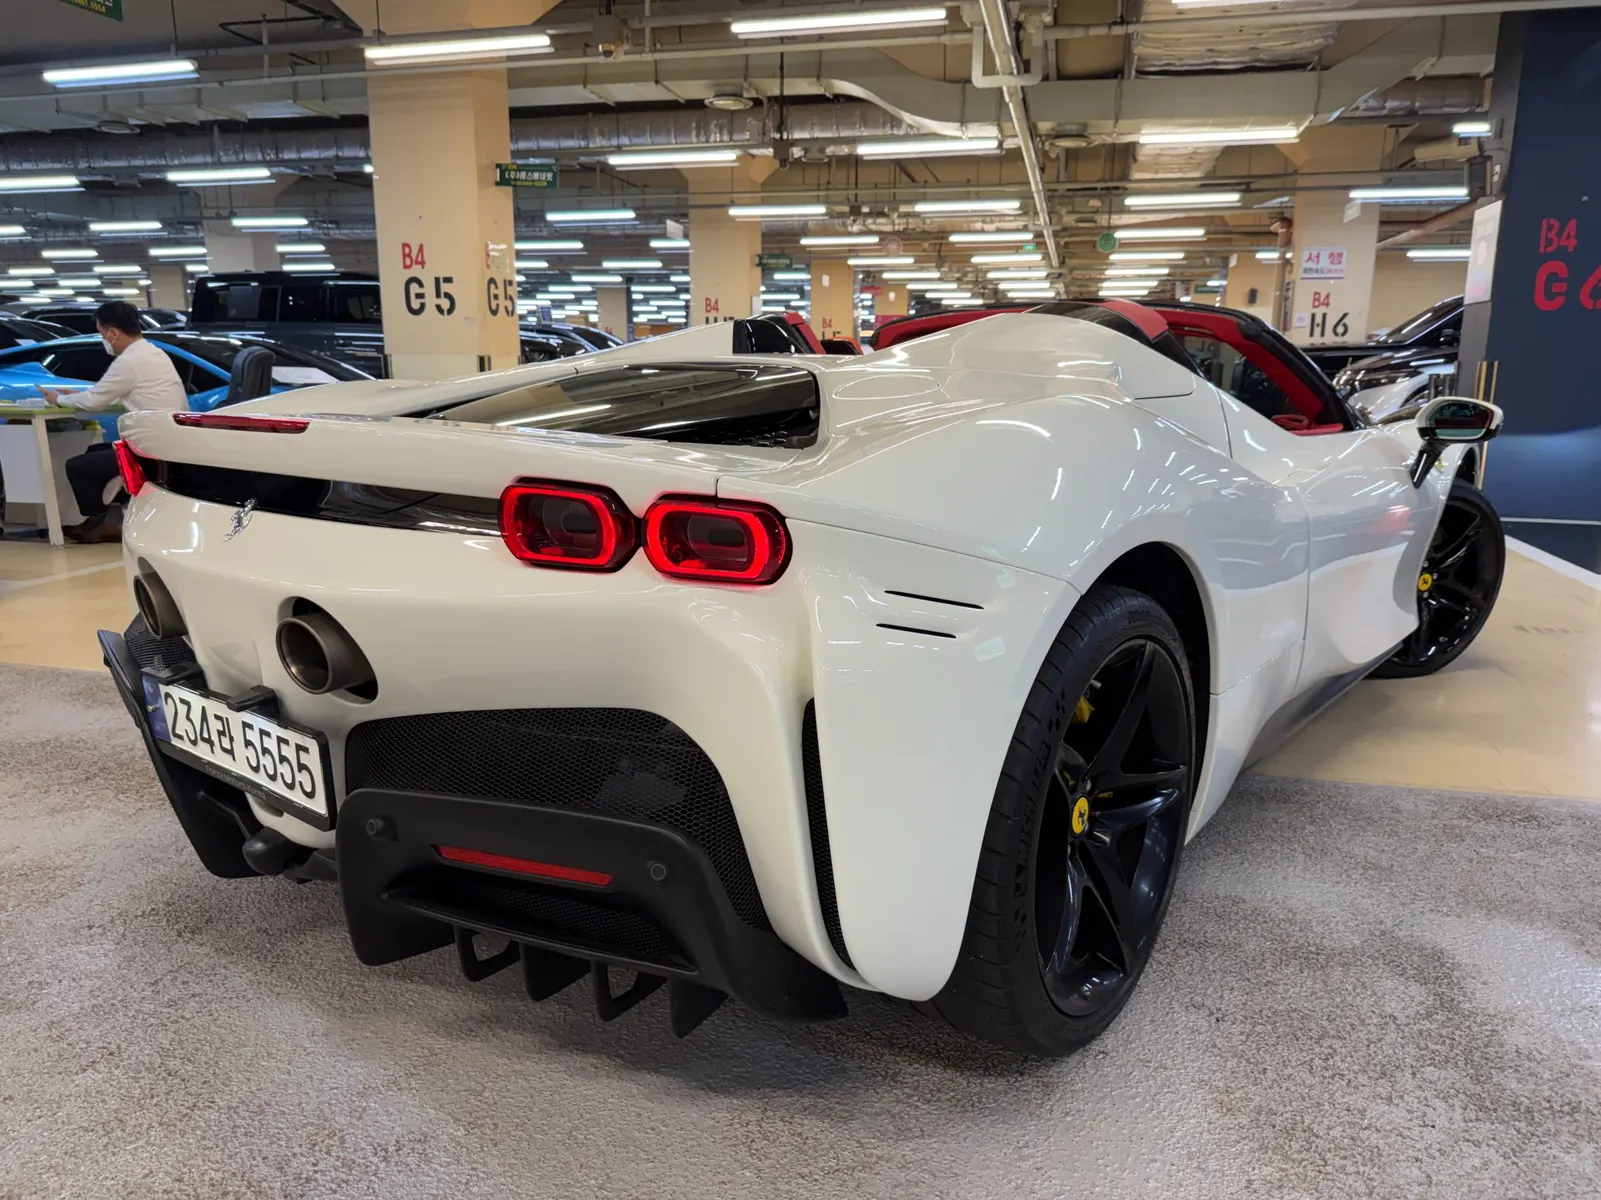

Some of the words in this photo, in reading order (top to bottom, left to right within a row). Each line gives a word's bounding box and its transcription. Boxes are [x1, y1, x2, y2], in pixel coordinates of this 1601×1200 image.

[1539, 218, 1577, 253] B4
[402, 242, 426, 270] B4
[705, 297, 719, 313] B4
[1312, 291, 1331, 309] B4
[163, 691, 236, 762] 234라
[241, 719, 317, 800] 5555
